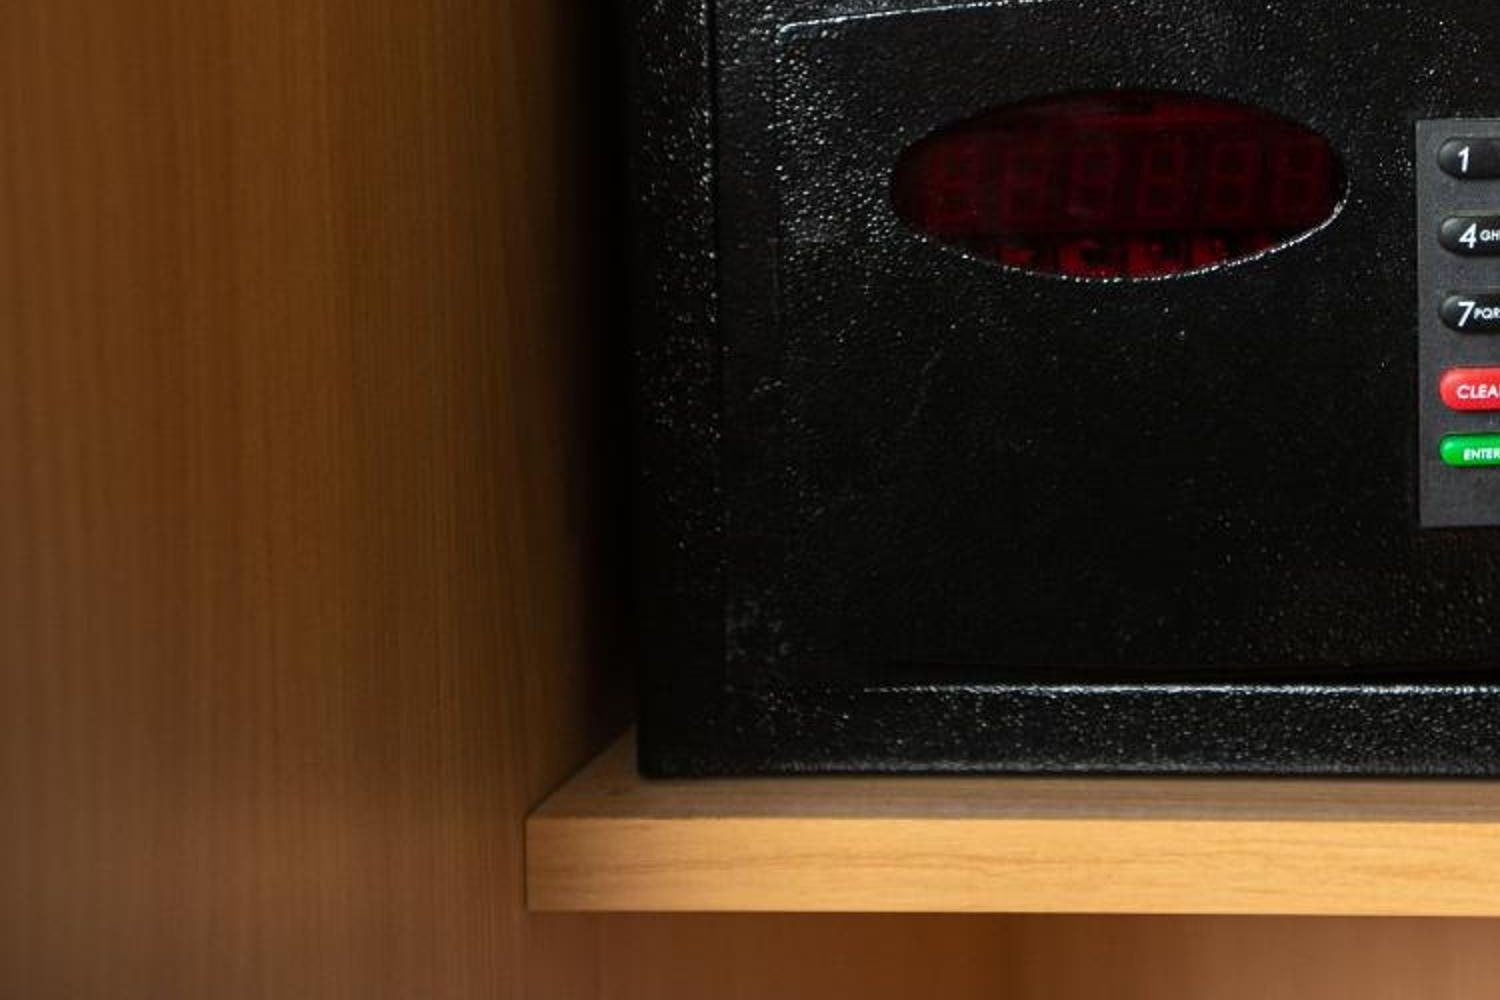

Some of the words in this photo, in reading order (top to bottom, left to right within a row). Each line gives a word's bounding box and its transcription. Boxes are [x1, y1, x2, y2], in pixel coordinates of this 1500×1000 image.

[1459, 147, 1469, 171] 1
[1459, 223, 1476, 248] 4
[1458, 301, 1474, 326] 7
[1464, 448, 1500, 460] ENTER
